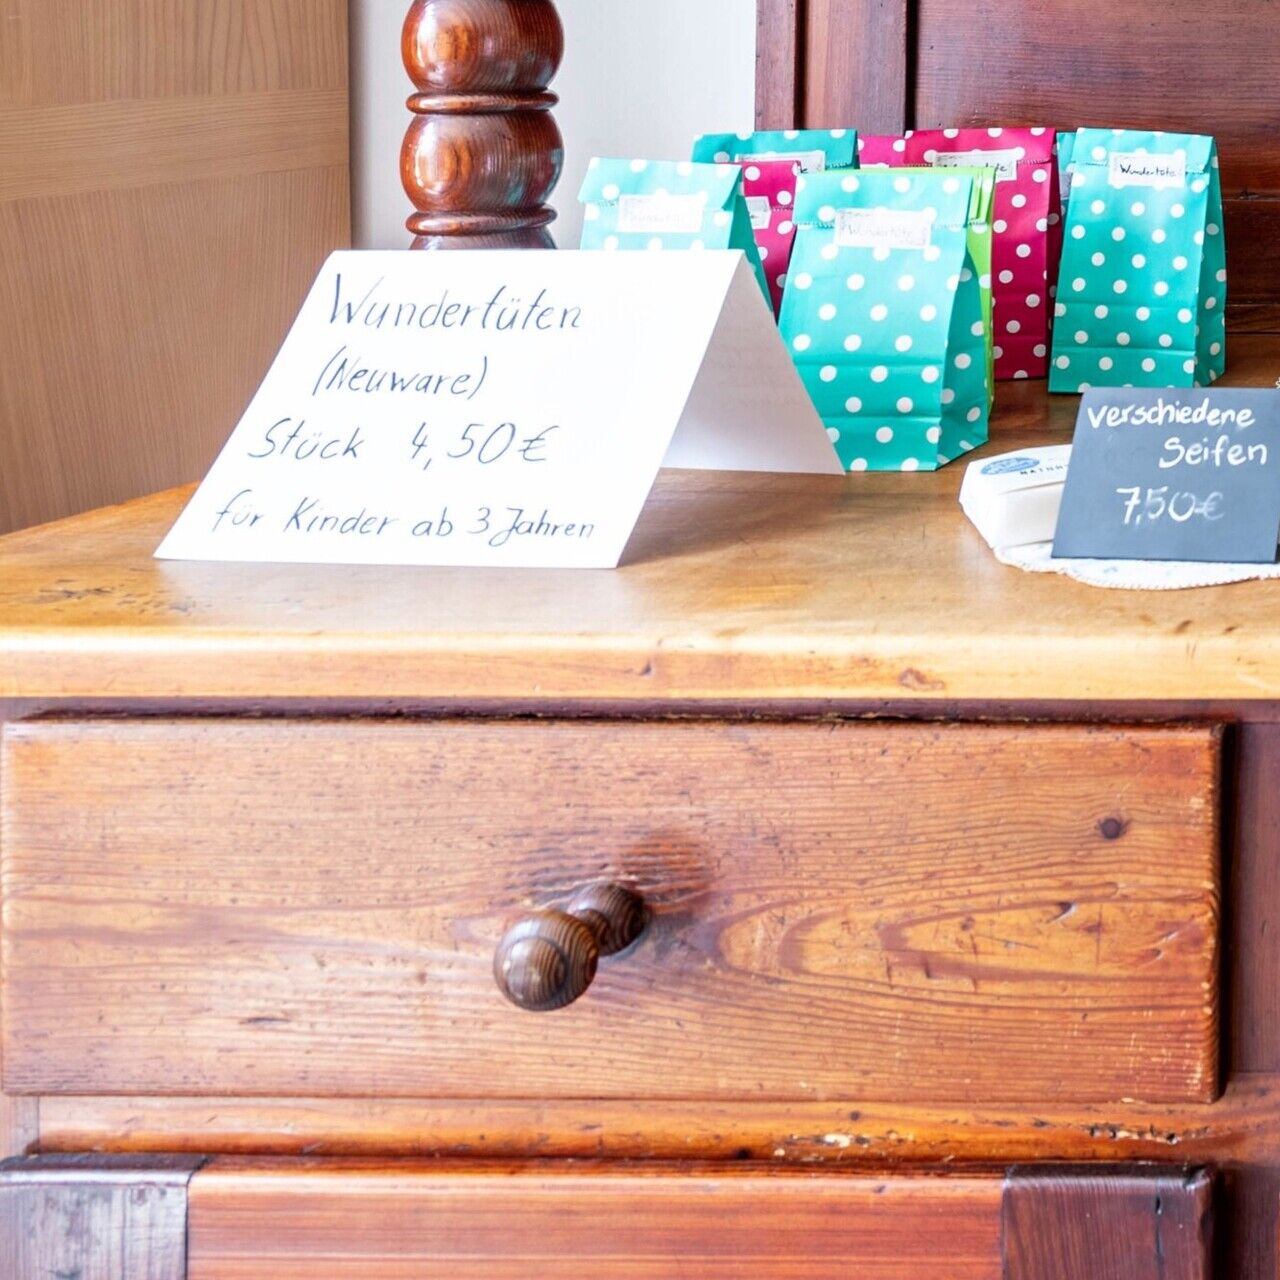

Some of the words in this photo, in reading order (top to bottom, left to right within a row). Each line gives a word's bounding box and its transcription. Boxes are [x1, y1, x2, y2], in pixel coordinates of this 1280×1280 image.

[327, 272, 582, 330] Wundertüten
[311, 346, 488, 400] (Neuware)
[1087, 398, 1257, 431] verschiedene
[247, 417, 365, 461] Stück
[410, 421, 560, 472] 4,50€
[1157, 436, 1269, 470] Seifen
[212, 488, 264, 533] für
[285, 498, 398, 535] Kinder
[410, 513, 454, 540] ab
[475, 507, 490, 534] 3
[489, 505, 597, 547] Jahren
[1116, 485, 1225, 526] 7,50€
